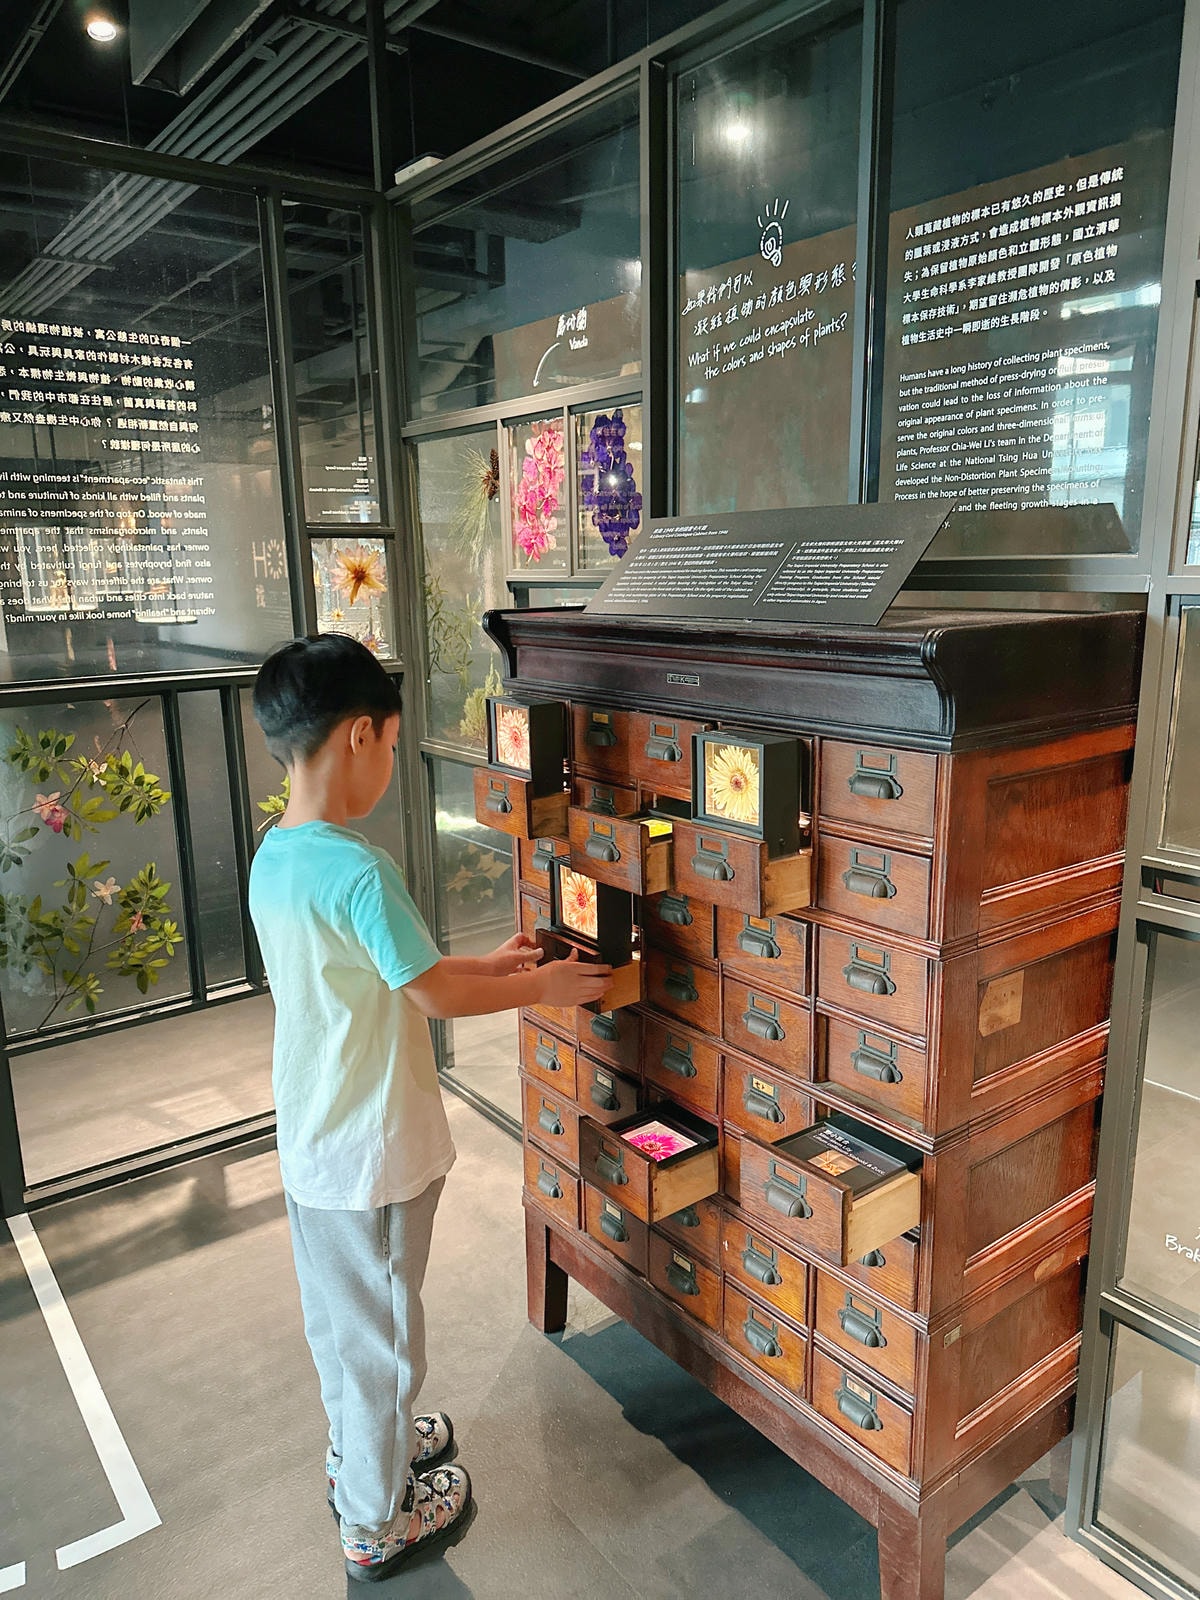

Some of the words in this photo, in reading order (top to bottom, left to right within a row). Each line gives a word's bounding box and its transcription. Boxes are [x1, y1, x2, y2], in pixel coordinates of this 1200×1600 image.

[688, 348, 709, 367] What
[713, 344, 720, 361] if
[723, 342, 736, 354] we
[740, 328, 761, 347] could
[764, 308, 815, 336] encapsulate
[704, 364, 720, 380] the
[723, 356, 746, 373] colors
[750, 348, 764, 362] and
[768, 338, 796, 360] shapes
[800, 328, 810, 347] of
[814, 312, 848, 346] plants?
[899, 371, 926, 381] Humans
[927, 368, 943, 377] have
[950, 365, 966, 374] long
[967, 361, 992, 371] history
[993, 358, 1002, 367] of
[1002, 354, 1040, 366] collecting
[1041, 349, 1061, 362] plant
[1063, 343, 1111, 358] specimens,
[898, 402, 919, 412] vation
[921, 398, 940, 409] could
[942, 396, 958, 406] lead
[960, 395, 968, 404] to
[971, 393, 983, 402] the
[986, 392, 1000, 400] loss
[1003, 389, 1012, 398] of
[1014, 383, 1061, 396] information
[1065, 378, 1089, 389] about
[1092, 376, 1107, 386] the
[899, 388, 910, 397] but
[911, 386, 923, 396] the
[923, 380, 959, 394] traditional
[960, 376, 988, 388] method
[989, 375, 998, 384] of
[998, 369, 1046, 385] press-drying
[897, 416, 922, 428] original
[923, 413, 963, 425] appearance
[965, 410, 974, 419] of
[975, 407, 994, 420] plant
[996, 404, 1038, 417] specimens.
[1040, 401, 1048, 410] In
[1051, 398, 1073, 408] order
[1074, 397, 1087, 405] to
[1086, 396, 1106, 406] pre-
[897, 433, 914, 441] serve
[916, 430, 927, 439] the
[929, 426, 955, 439] original
[956, 425, 978, 435] colors
[979, 422, 994, 432] and
[896, 446, 918, 457] plants,
[919, 444, 949, 453] Professor
[951, 439, 982, 450] Chia-Wei
[997, 438, 1016, 446] team
[1018, 436, 1025, 444] in
[1028, 434, 1041, 443] the
[895, 462, 908, 471] Life
[910, 461, 936, 470] Science
[939, 458, 948, 467] at
[949, 457, 961, 466] the
[964, 454, 995, 465] National
[998, 452, 1020, 462] Tsing
[1021, 451, 1037, 460] Hua
[894, 492, 918, 500] Process
[919, 490, 926, 499] in
[927, 489, 938, 498] the
[939, 489, 957, 499] hope
[958, 487, 967, 496] of
[967, 486, 989, 496] better
[990, 484, 1029, 496] preserving
[1031, 483, 1044, 491] the
[1046, 481, 1087, 492] specimens
[1090, 479, 1098, 488] of
[895, 475, 929, 486] developed
[930, 474, 942, 483] the
[944, 470, 995, 482] Non-Distortion
[998, 468, 1017, 478] Plant
[958, 502, 971, 512] and
[974, 502, 986, 511] the
[989, 500, 1017, 511] fleeting
[1020, 498, 1048, 510] growth
